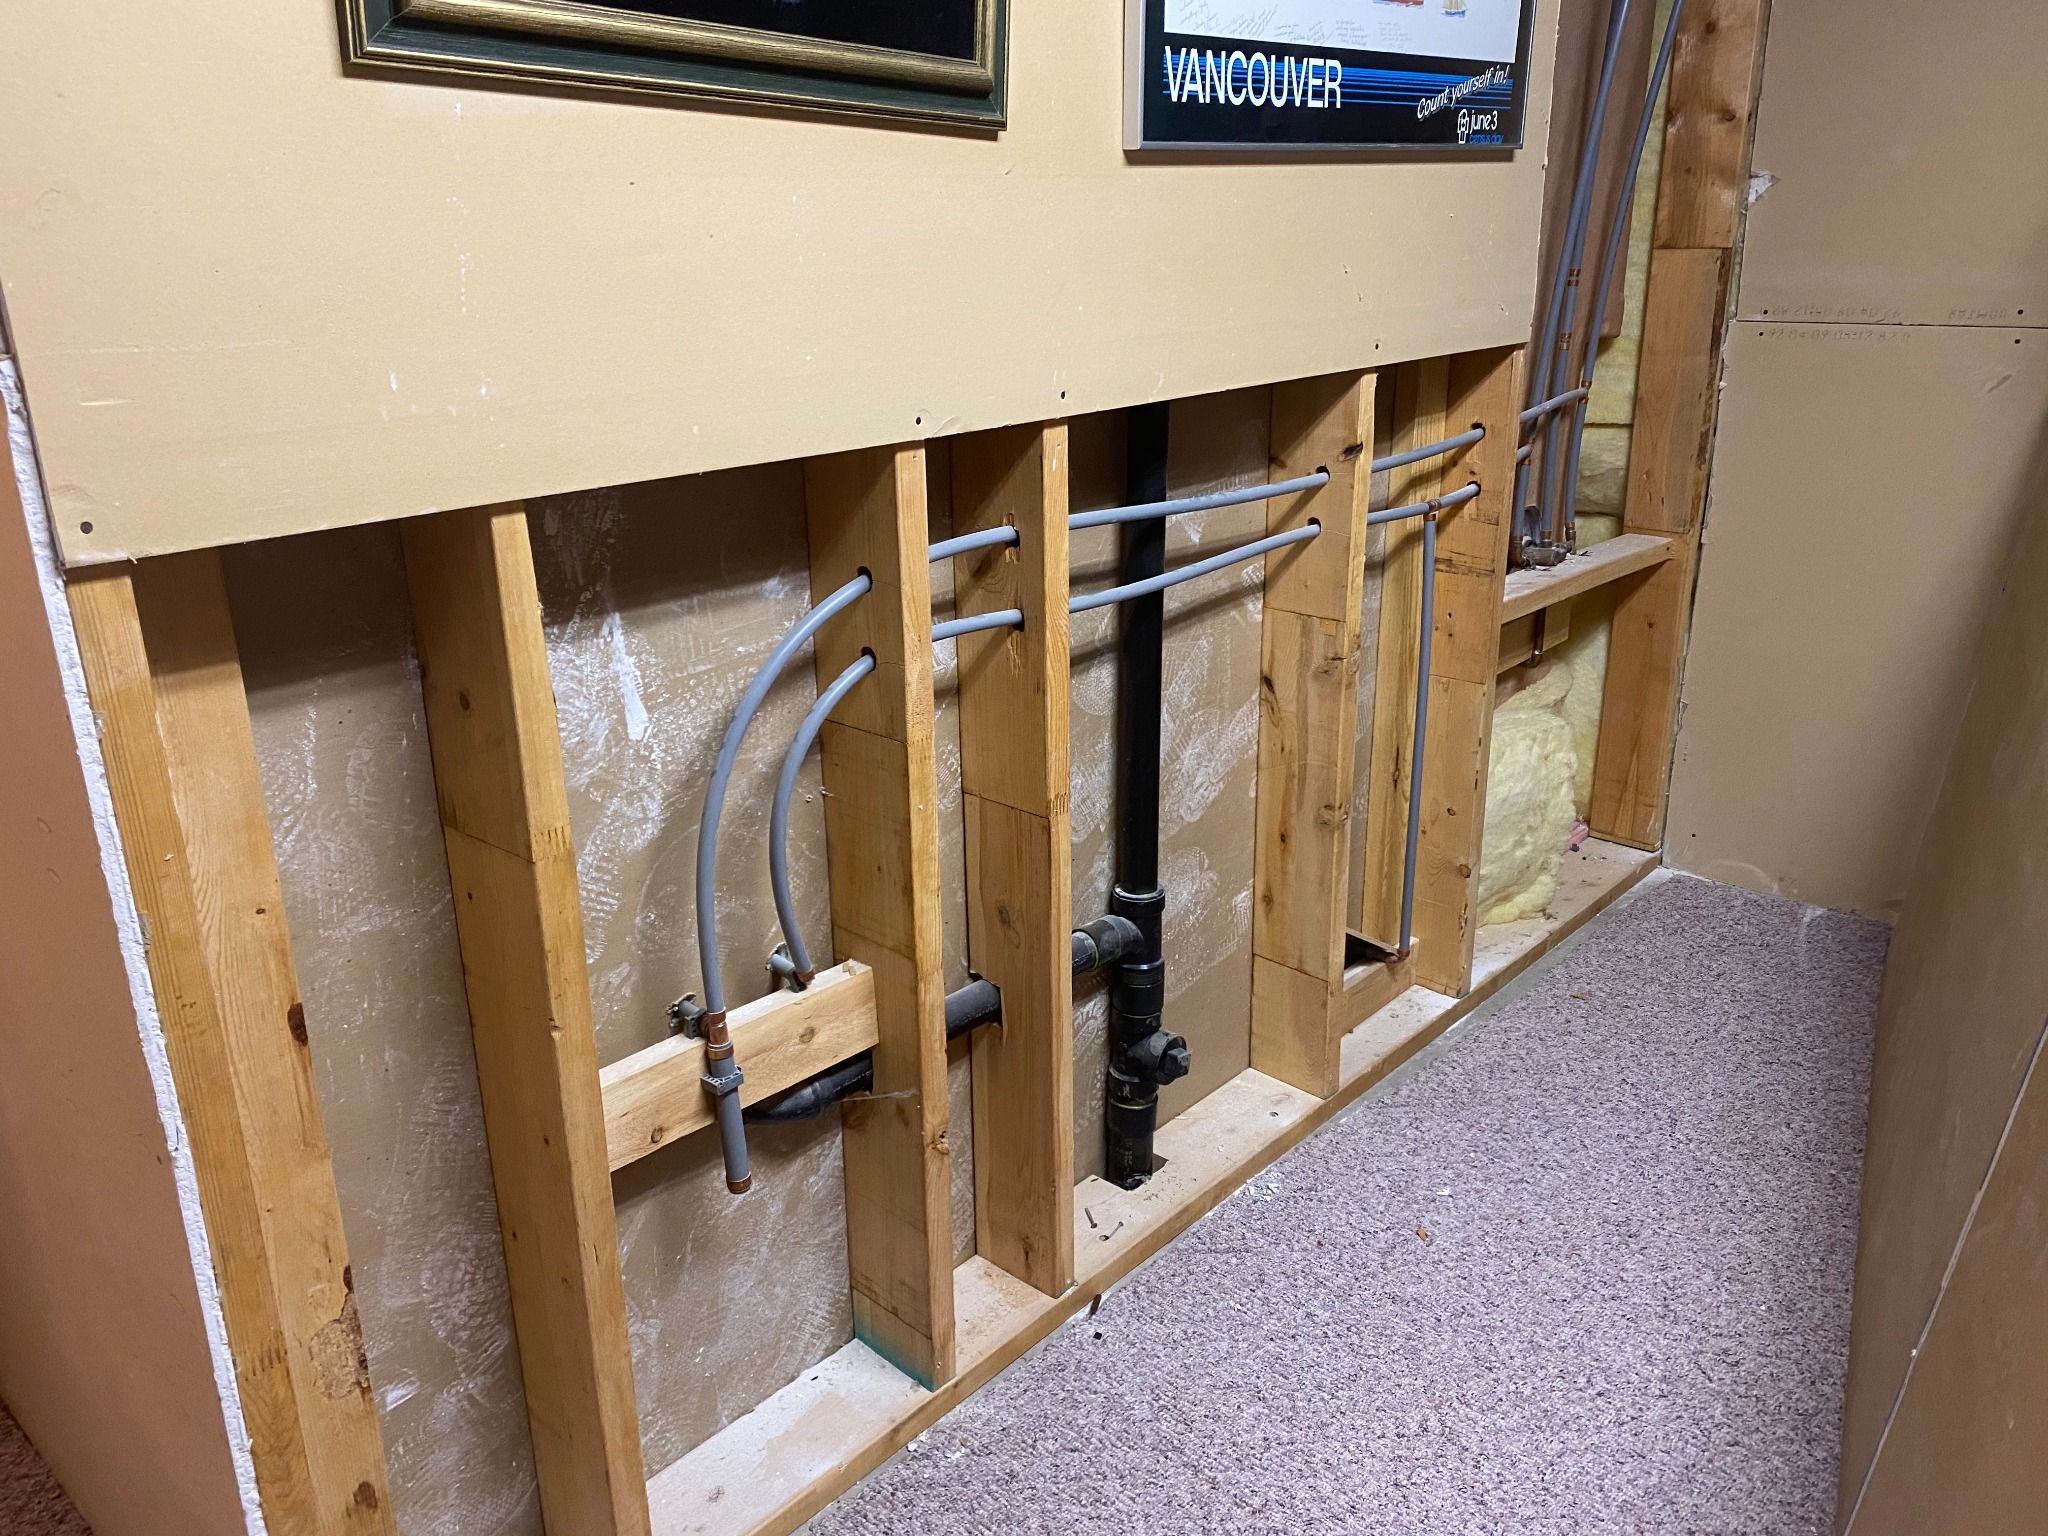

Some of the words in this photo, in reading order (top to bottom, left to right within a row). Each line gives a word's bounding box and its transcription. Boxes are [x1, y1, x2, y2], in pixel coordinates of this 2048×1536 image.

[1164, 46, 1342, 109] VANCOUVER
[1417, 86, 1449, 119] Count
[1450, 67, 1494, 108] yourself
[1493, 64, 1510, 84] in!
[1469, 109, 1491, 134] june
[1491, 110, 1498, 130] 3
